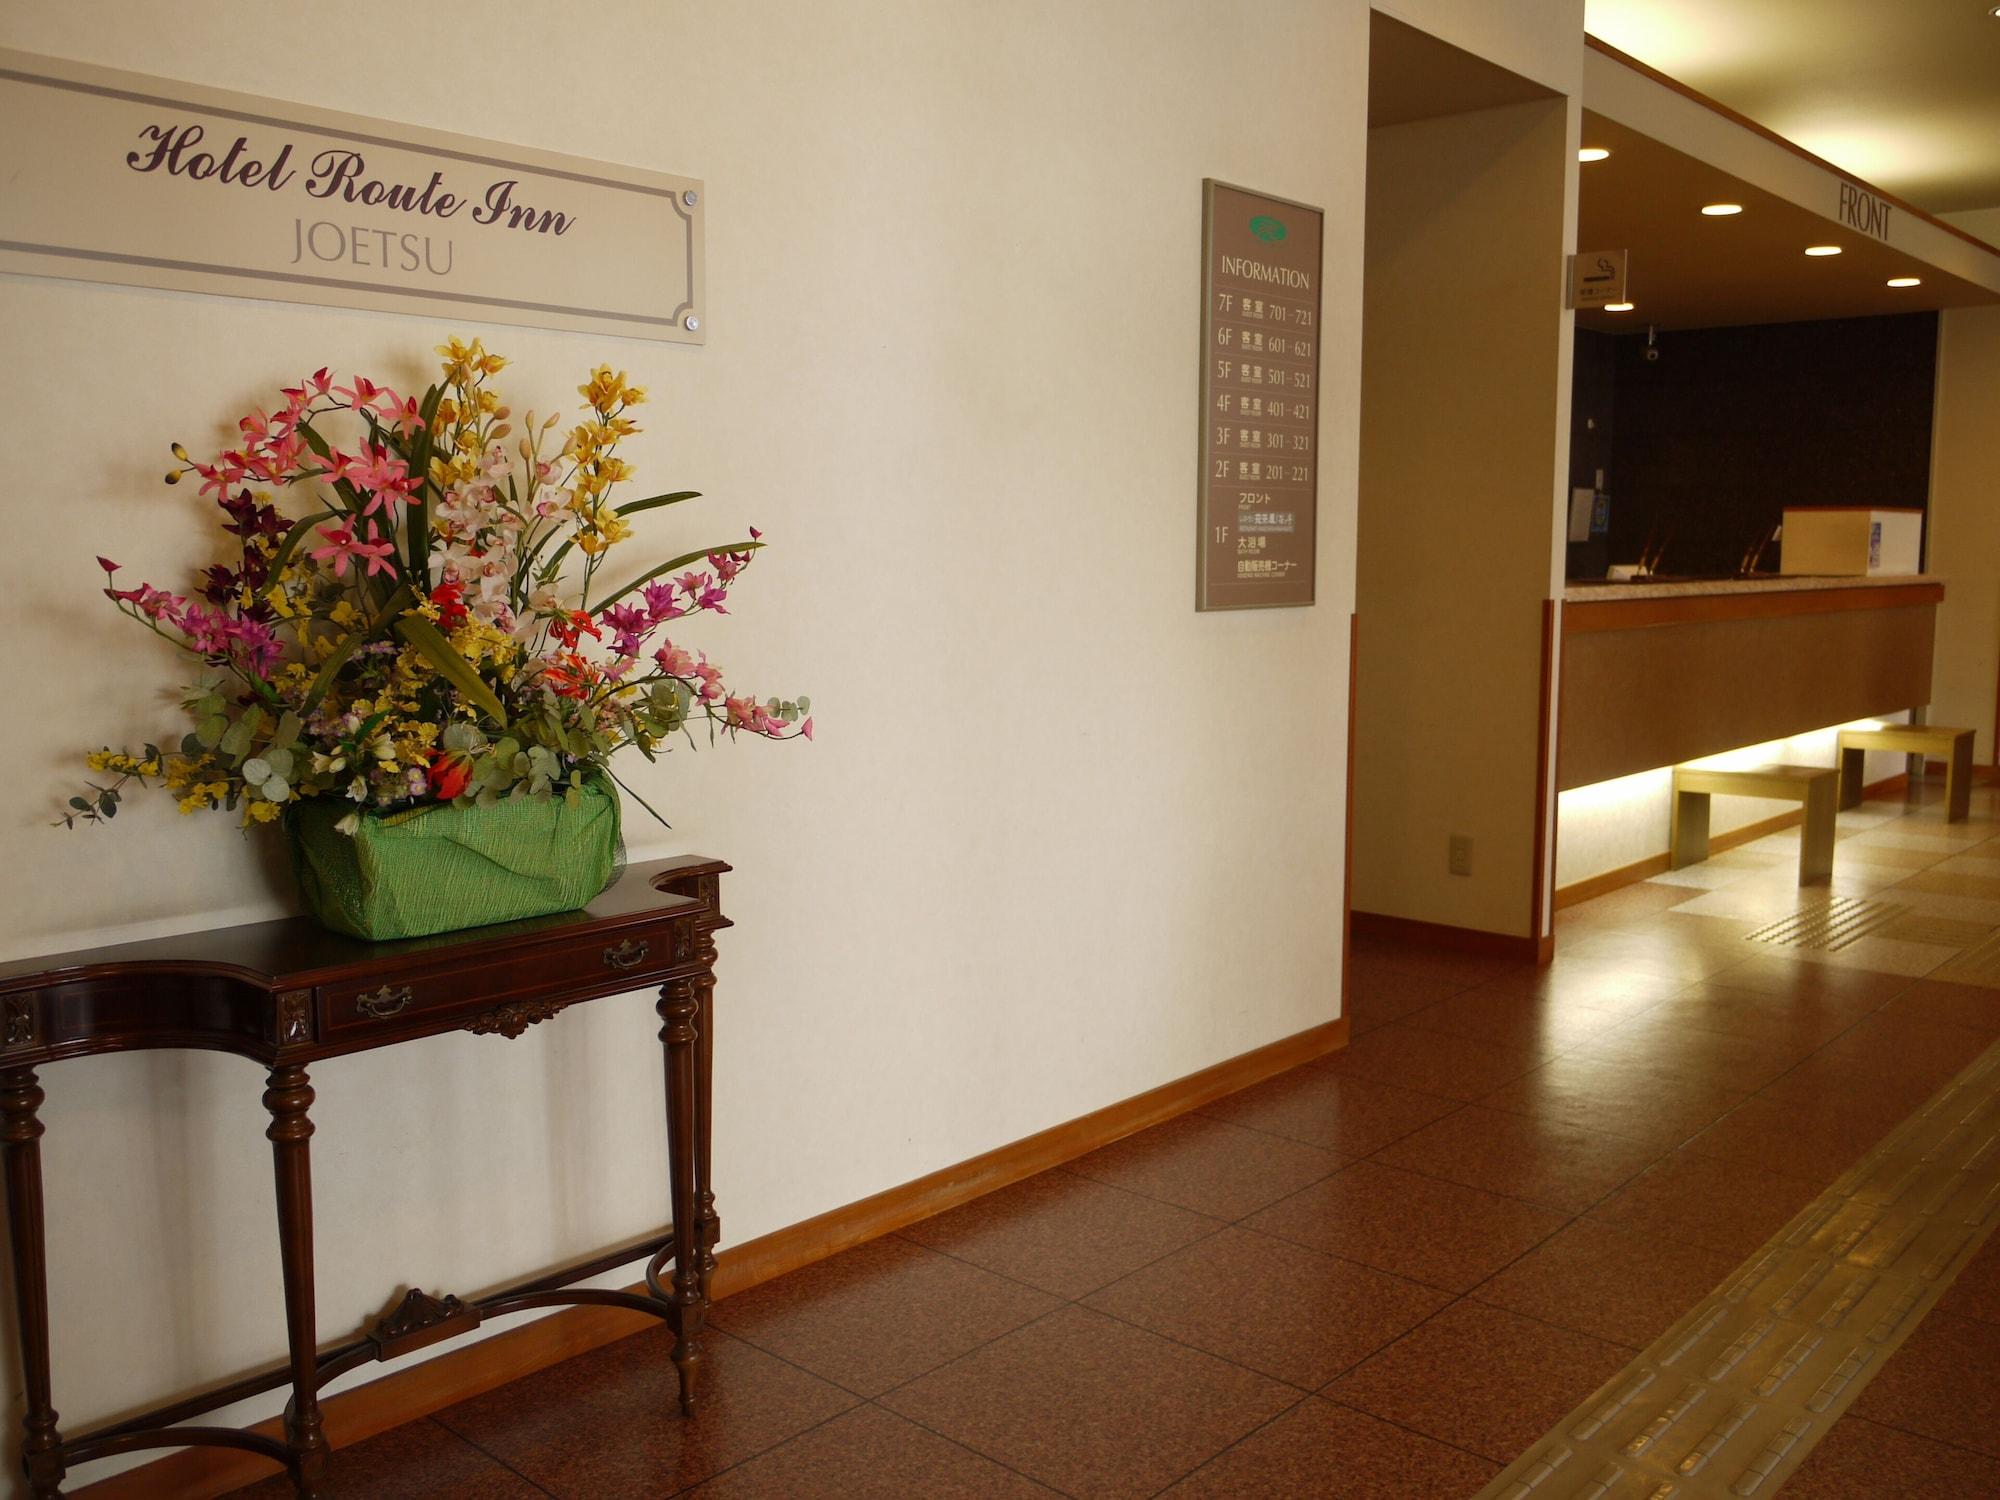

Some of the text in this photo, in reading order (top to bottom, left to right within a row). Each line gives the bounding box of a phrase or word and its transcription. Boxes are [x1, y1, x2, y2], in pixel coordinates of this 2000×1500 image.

[126, 125, 576, 235] Hotel Route Inn
[1840, 182, 1891, 240] FRONT
[290, 218, 453, 275] JOETSU
[1222, 255, 1310, 289] INFORMATION
[1219, 293, 1233, 312] 7F
[1218, 328, 1232, 345] 6F
[1217, 361, 1232, 378] 5F
[1216, 394, 1231, 412] 4F
[1216, 427, 1231, 445] 3F
[1215, 461, 1230, 478] 2F
[1239, 492, 1271, 504] フロント
[1215, 526, 1229, 543] 1F
